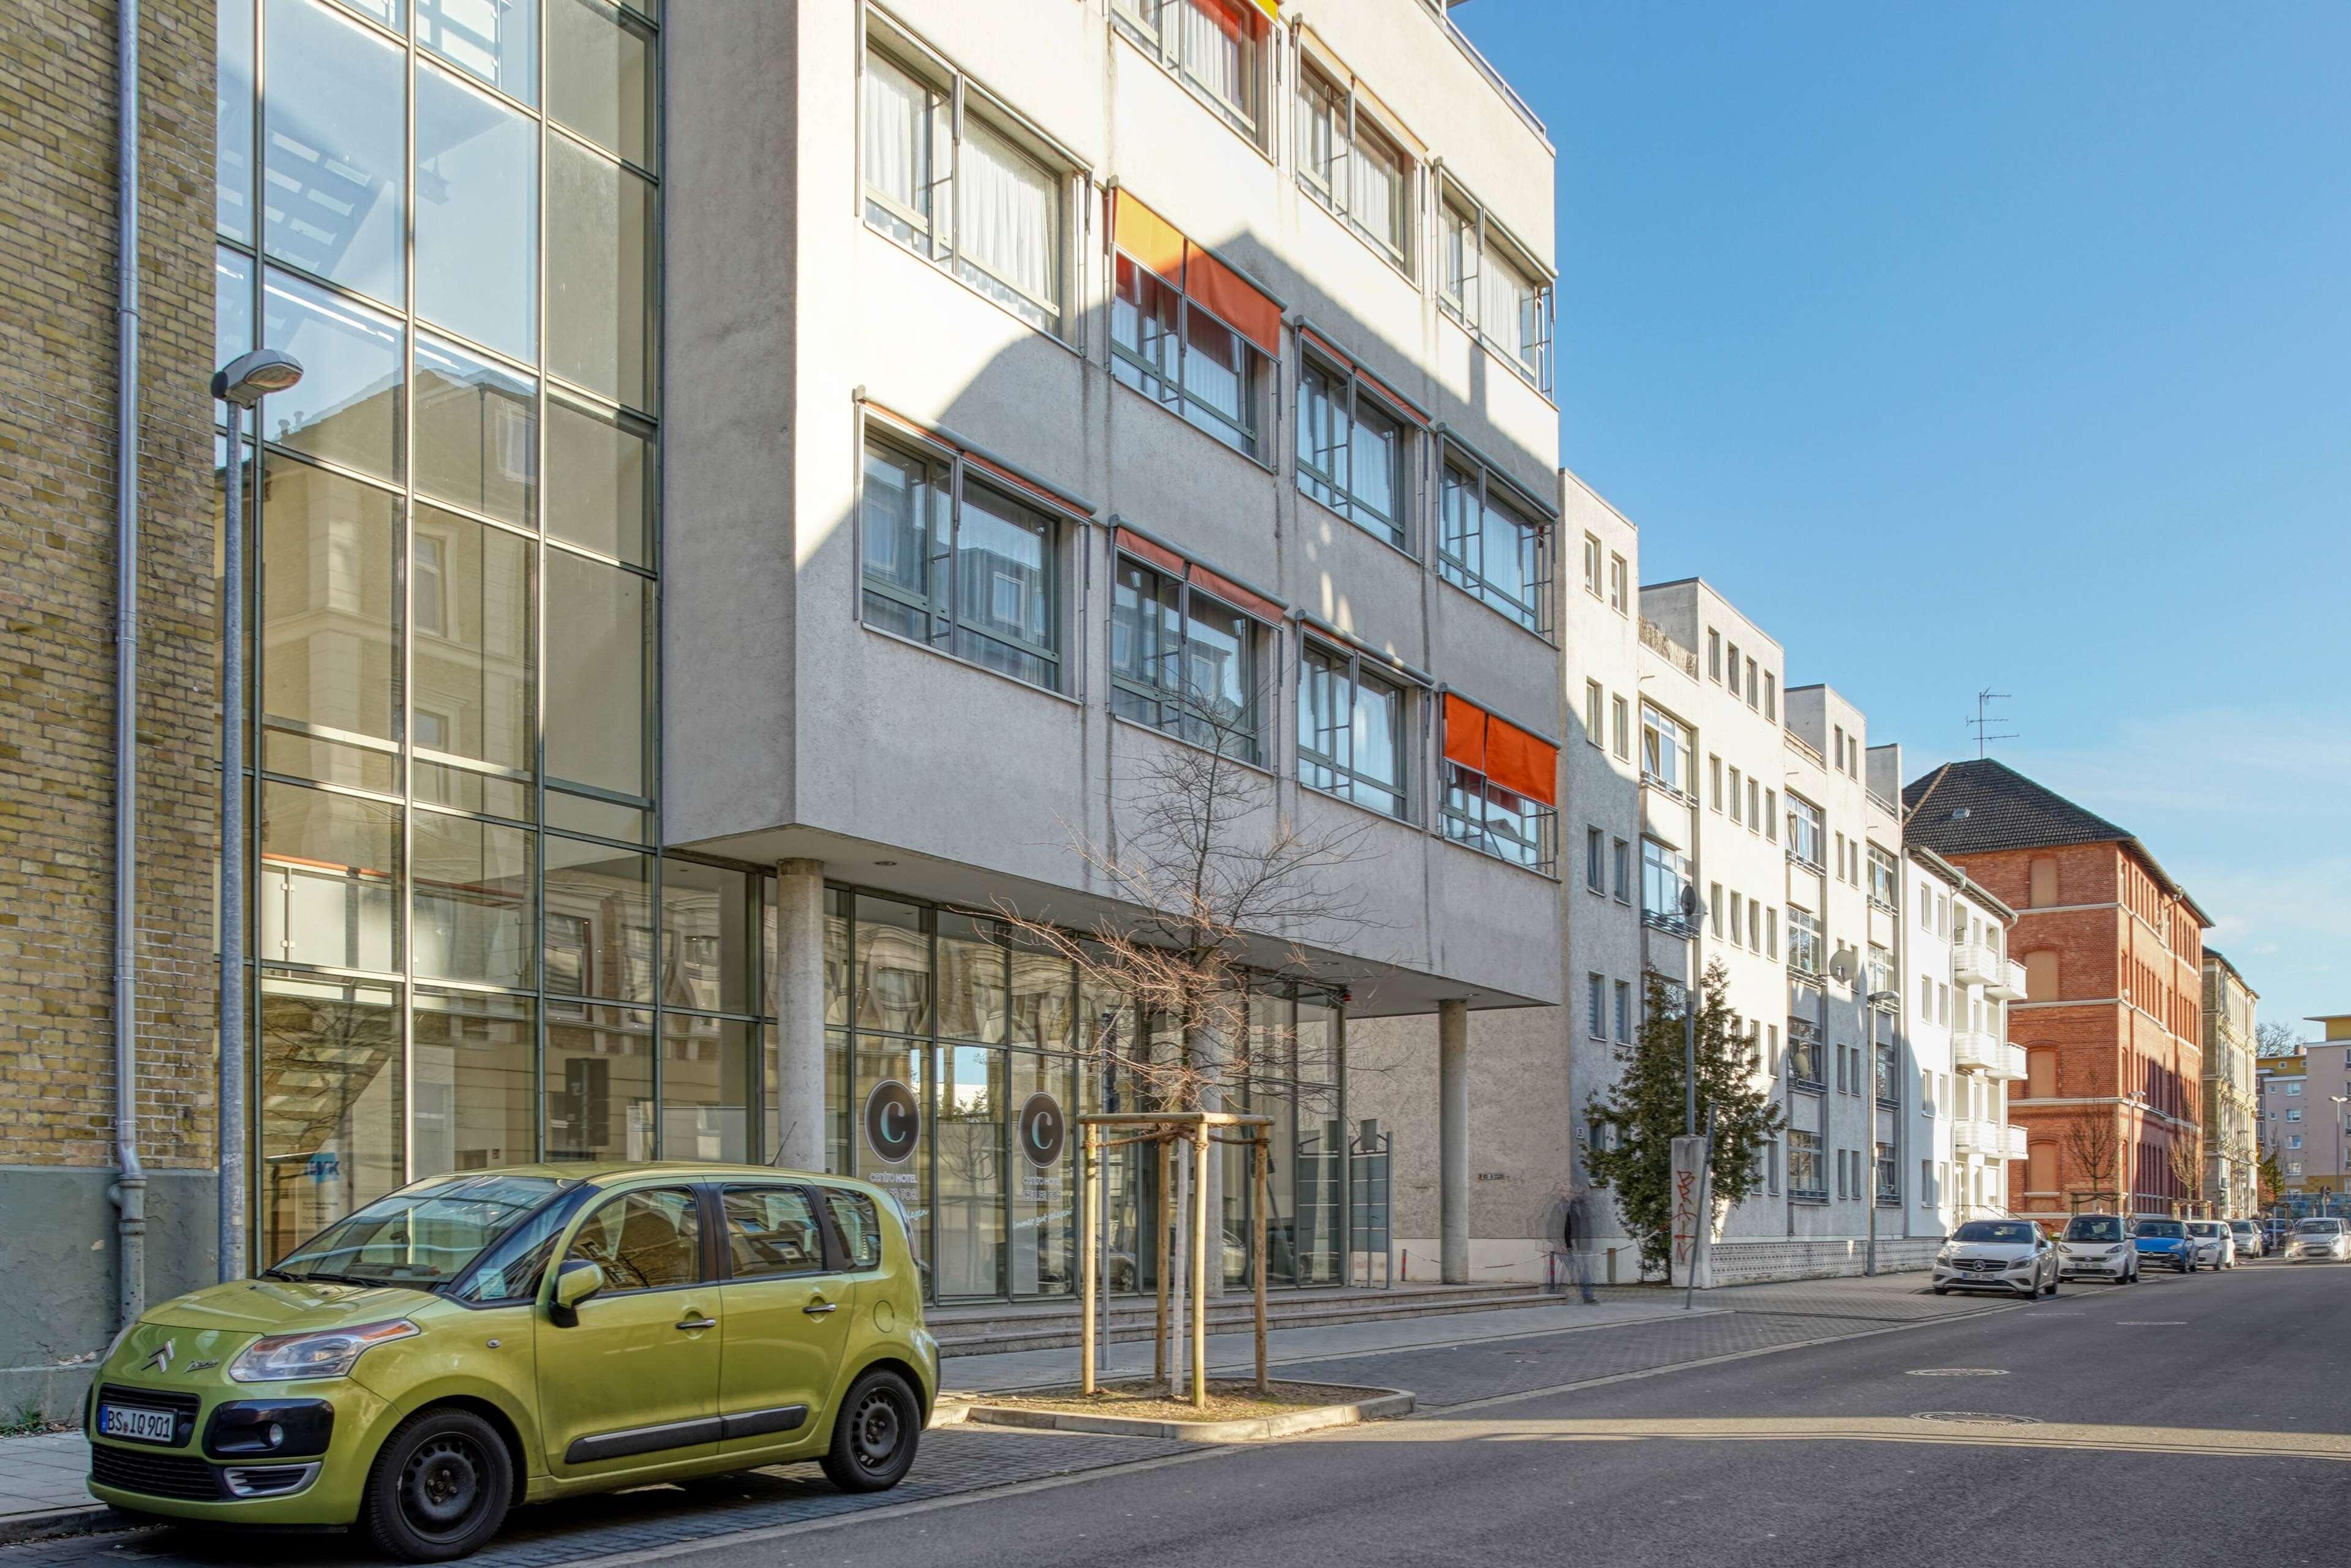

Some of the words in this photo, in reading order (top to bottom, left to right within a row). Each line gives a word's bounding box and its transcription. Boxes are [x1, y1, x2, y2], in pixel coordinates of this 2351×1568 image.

[881, 1101, 906, 1142] C
[1031, 1111, 1053, 1149] C
[895, 1174, 917, 1183] HOTEL
[108, 1410, 122, 1431] BS
[130, 1412, 146, 1435] IQ
[148, 1415, 170, 1438] 901
